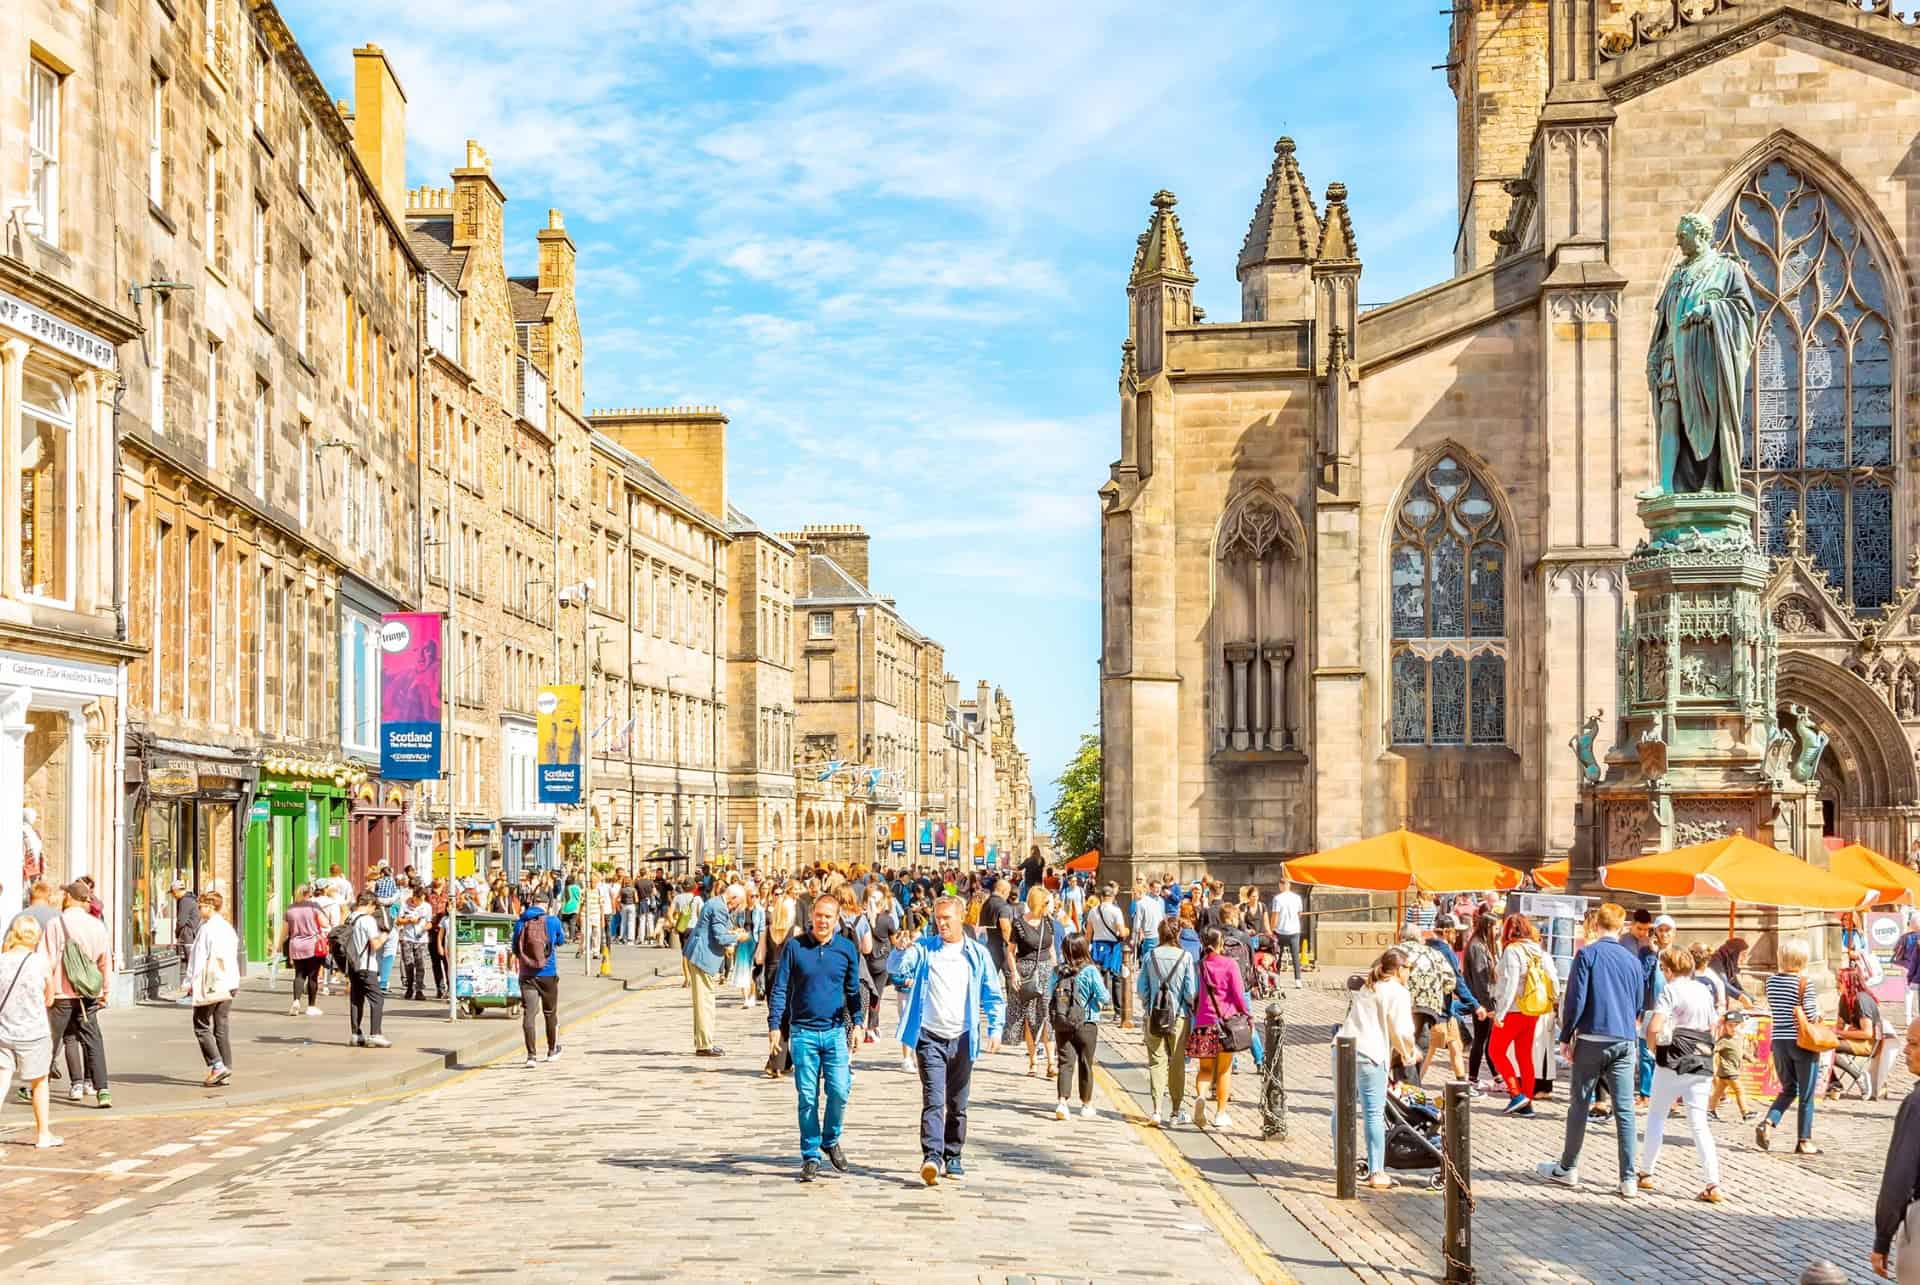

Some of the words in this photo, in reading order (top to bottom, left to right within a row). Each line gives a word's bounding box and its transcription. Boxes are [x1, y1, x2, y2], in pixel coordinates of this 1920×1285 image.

[0, 299, 19, 322] OF
[31, 313, 111, 363] EDINBURGH
[390, 731, 432, 743] Scotland
[544, 769, 575, 778] Scotland
